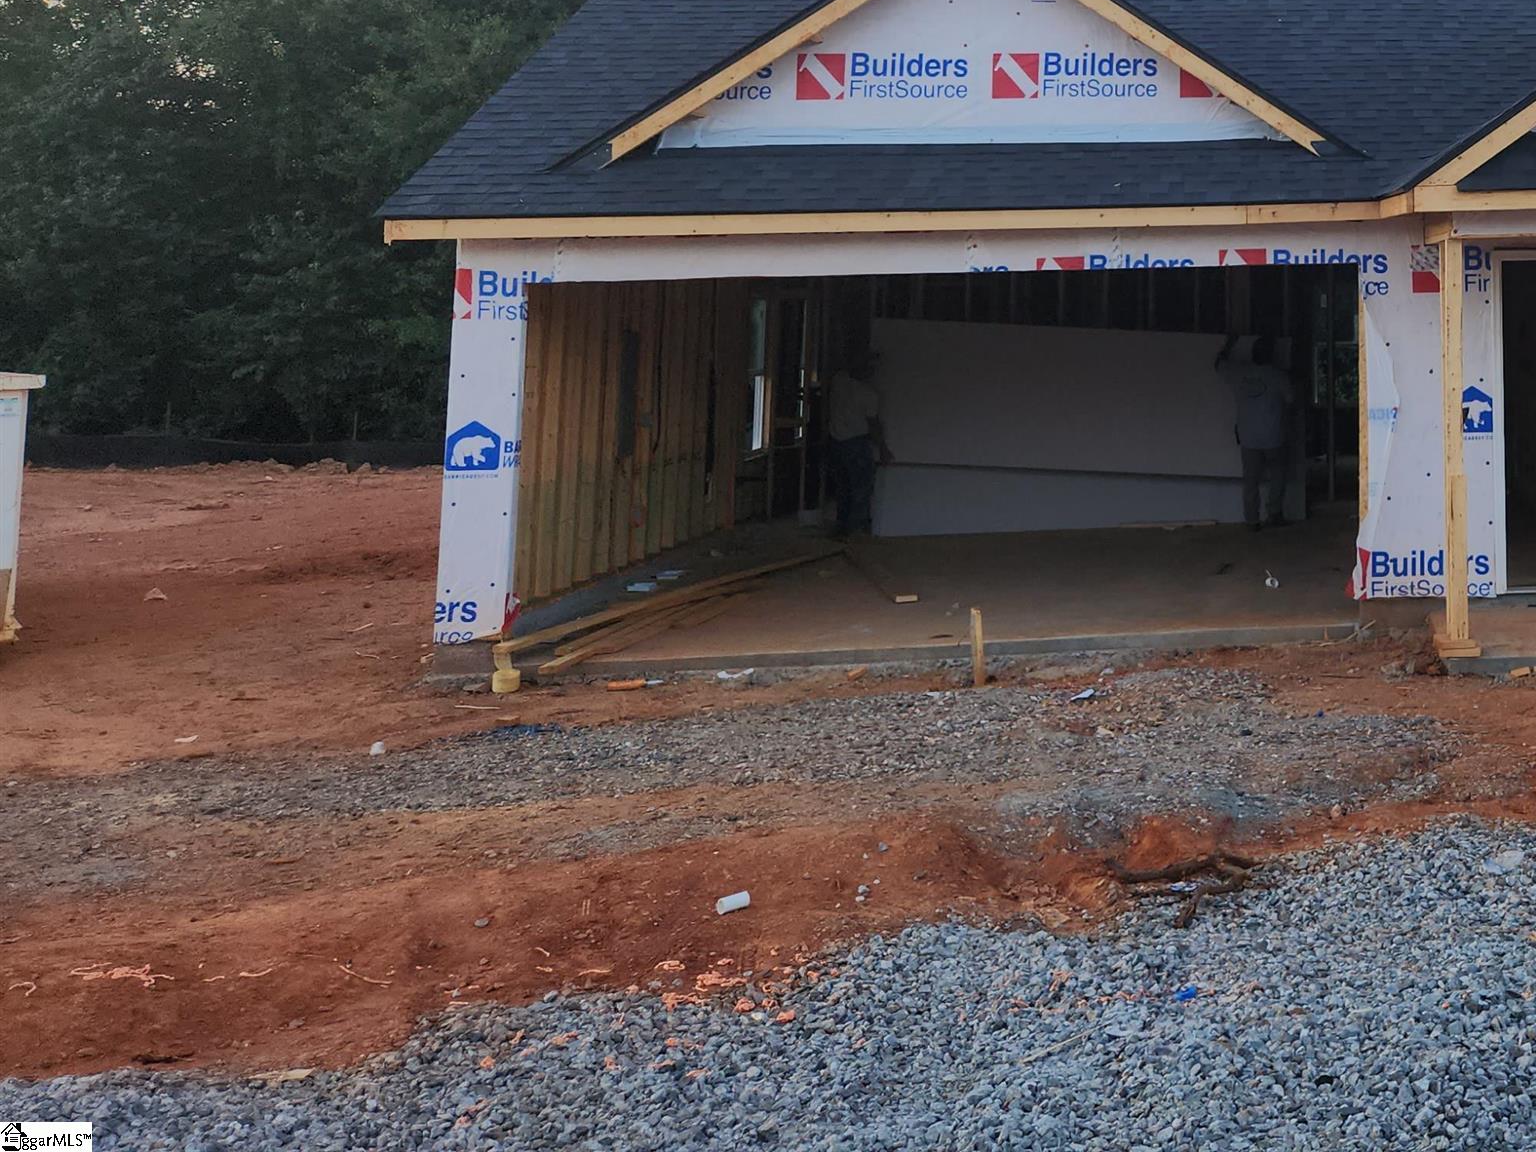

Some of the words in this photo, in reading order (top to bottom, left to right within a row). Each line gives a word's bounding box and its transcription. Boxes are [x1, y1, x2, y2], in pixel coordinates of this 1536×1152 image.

[850, 52, 968, 77] Builders
[1043, 52, 1158, 76] Builders
[850, 79, 968, 98] FirstSource
[1043, 79, 1158, 97] FirstSource
